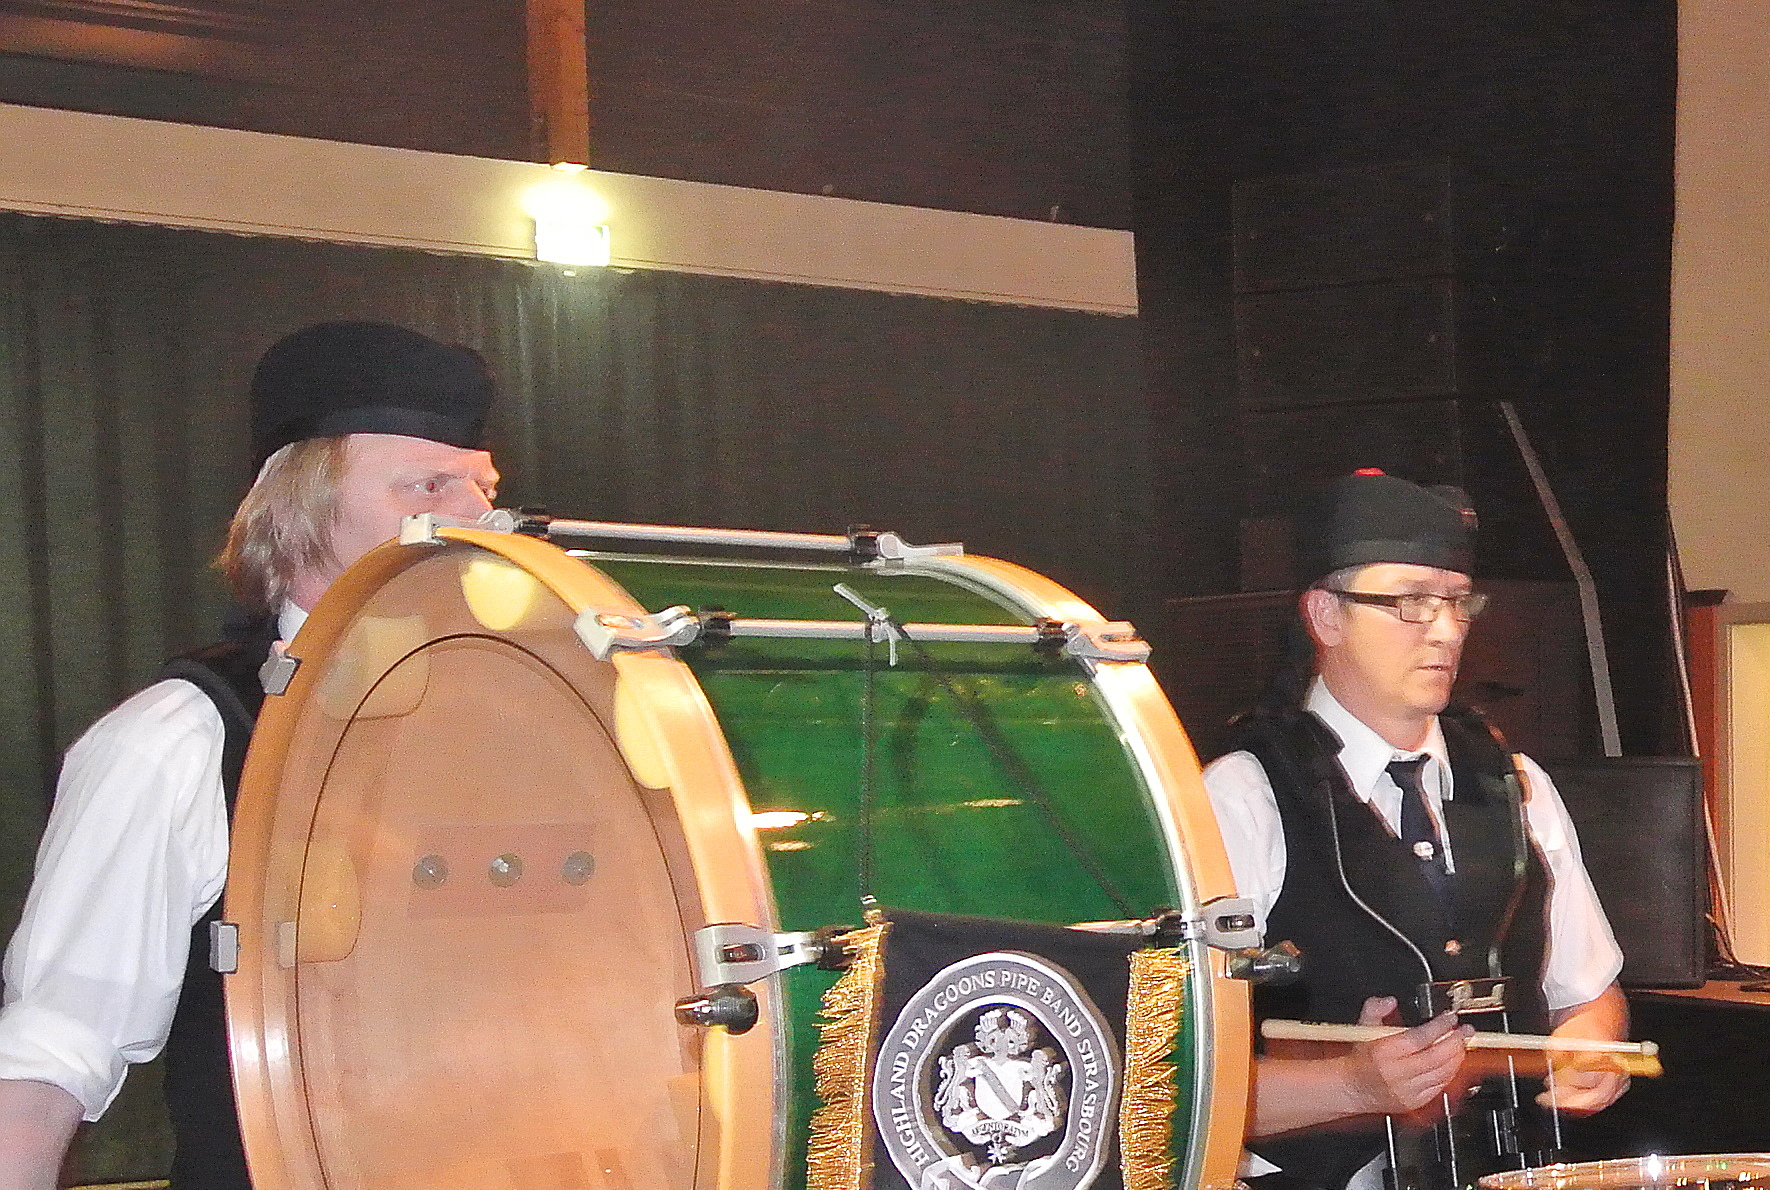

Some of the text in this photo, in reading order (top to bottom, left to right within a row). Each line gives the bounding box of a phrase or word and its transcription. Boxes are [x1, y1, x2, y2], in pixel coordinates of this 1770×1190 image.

[890, 970, 1100, 1173] HIGHLAND DRAGOONS PIPE BAND STRASBOURG
